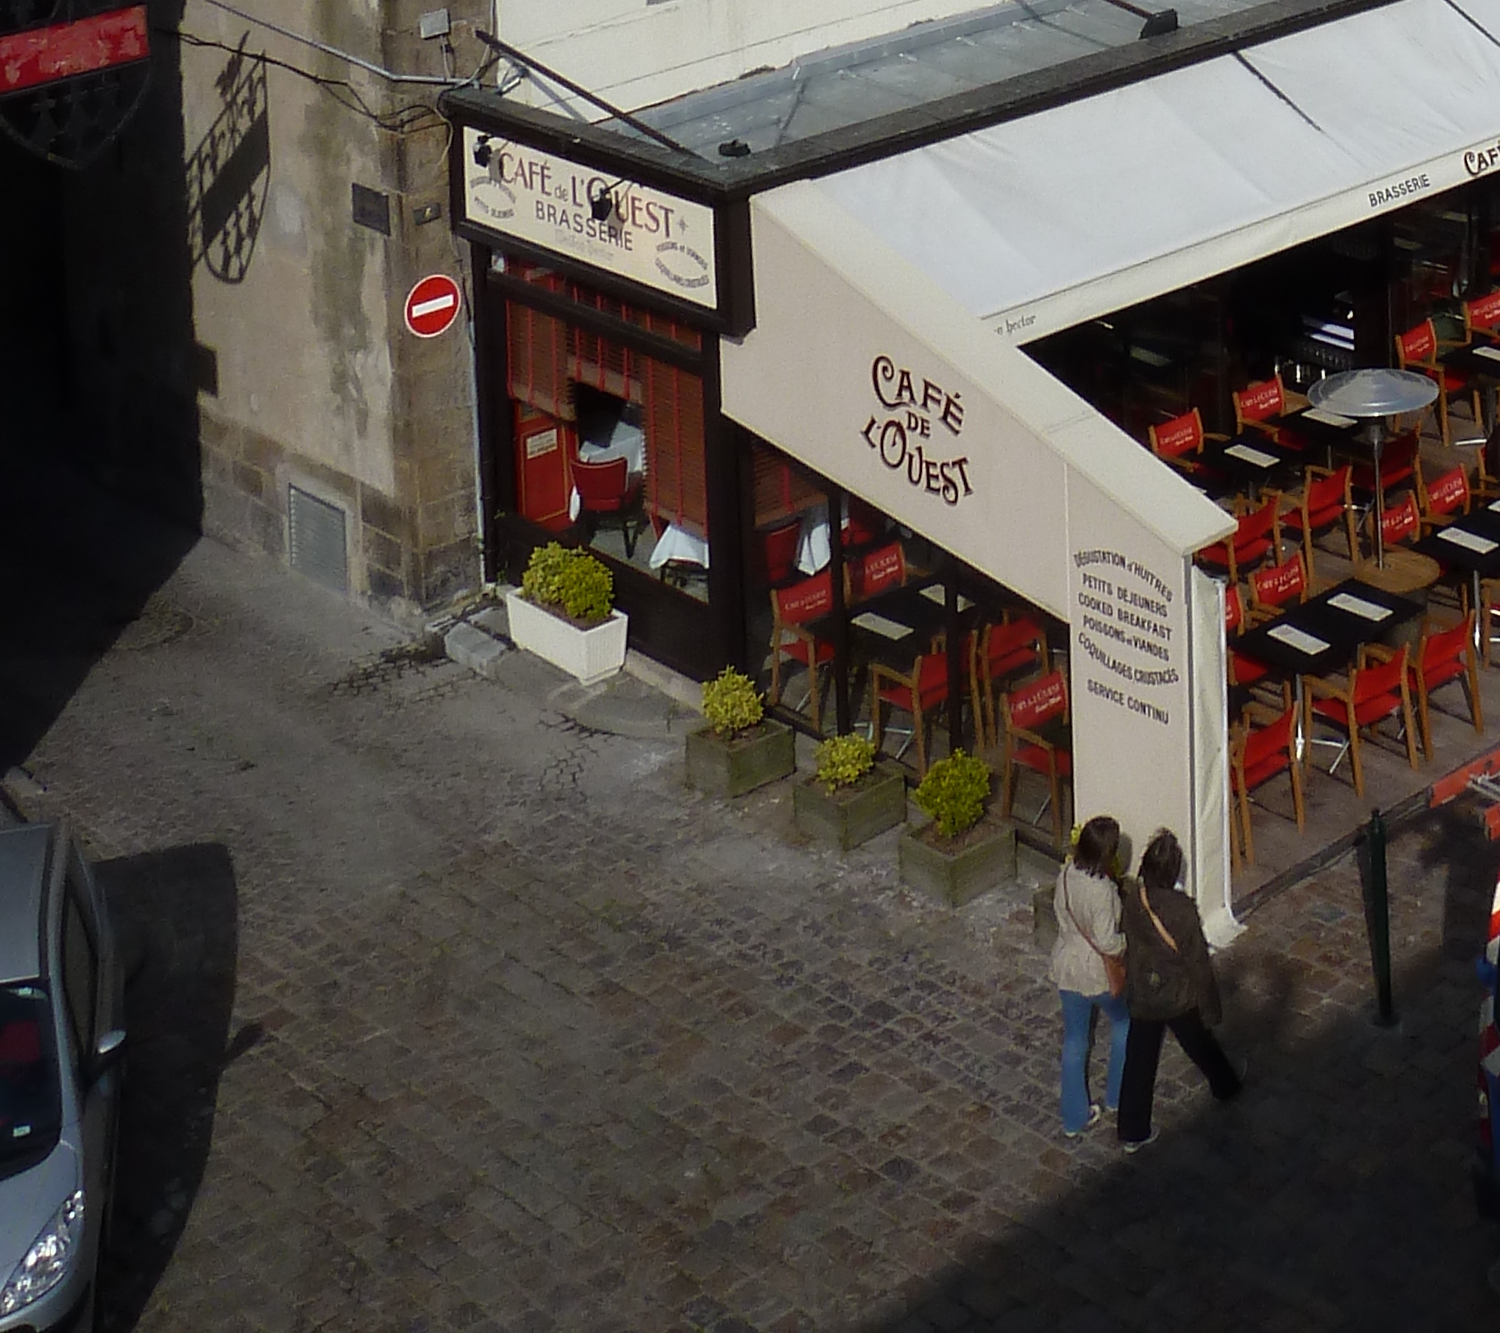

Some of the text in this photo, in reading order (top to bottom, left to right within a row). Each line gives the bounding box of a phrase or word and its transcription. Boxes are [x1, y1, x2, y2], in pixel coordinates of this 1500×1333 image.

[500, 152, 552, 198] CAFÉ
[554, 184, 568, 201] de
[1368, 174, 1430, 207] BRASSERIE
[536, 199, 633, 251] BRASSERIE
[872, 355, 964, 436] CAFÉ
[906, 411, 930, 439] DE
[861, 414, 973, 506] L'OUEST
[1083, 573, 1113, 595] PETITS
[1078, 592, 1172, 641] COOKED BREAKFAST
[1083, 614, 1125, 643] POISSONS
[1133, 635, 1169, 662] VIANDES
[1087, 678, 1124, 706] SERVICE
[1127, 696, 1169, 725] CONTINU
